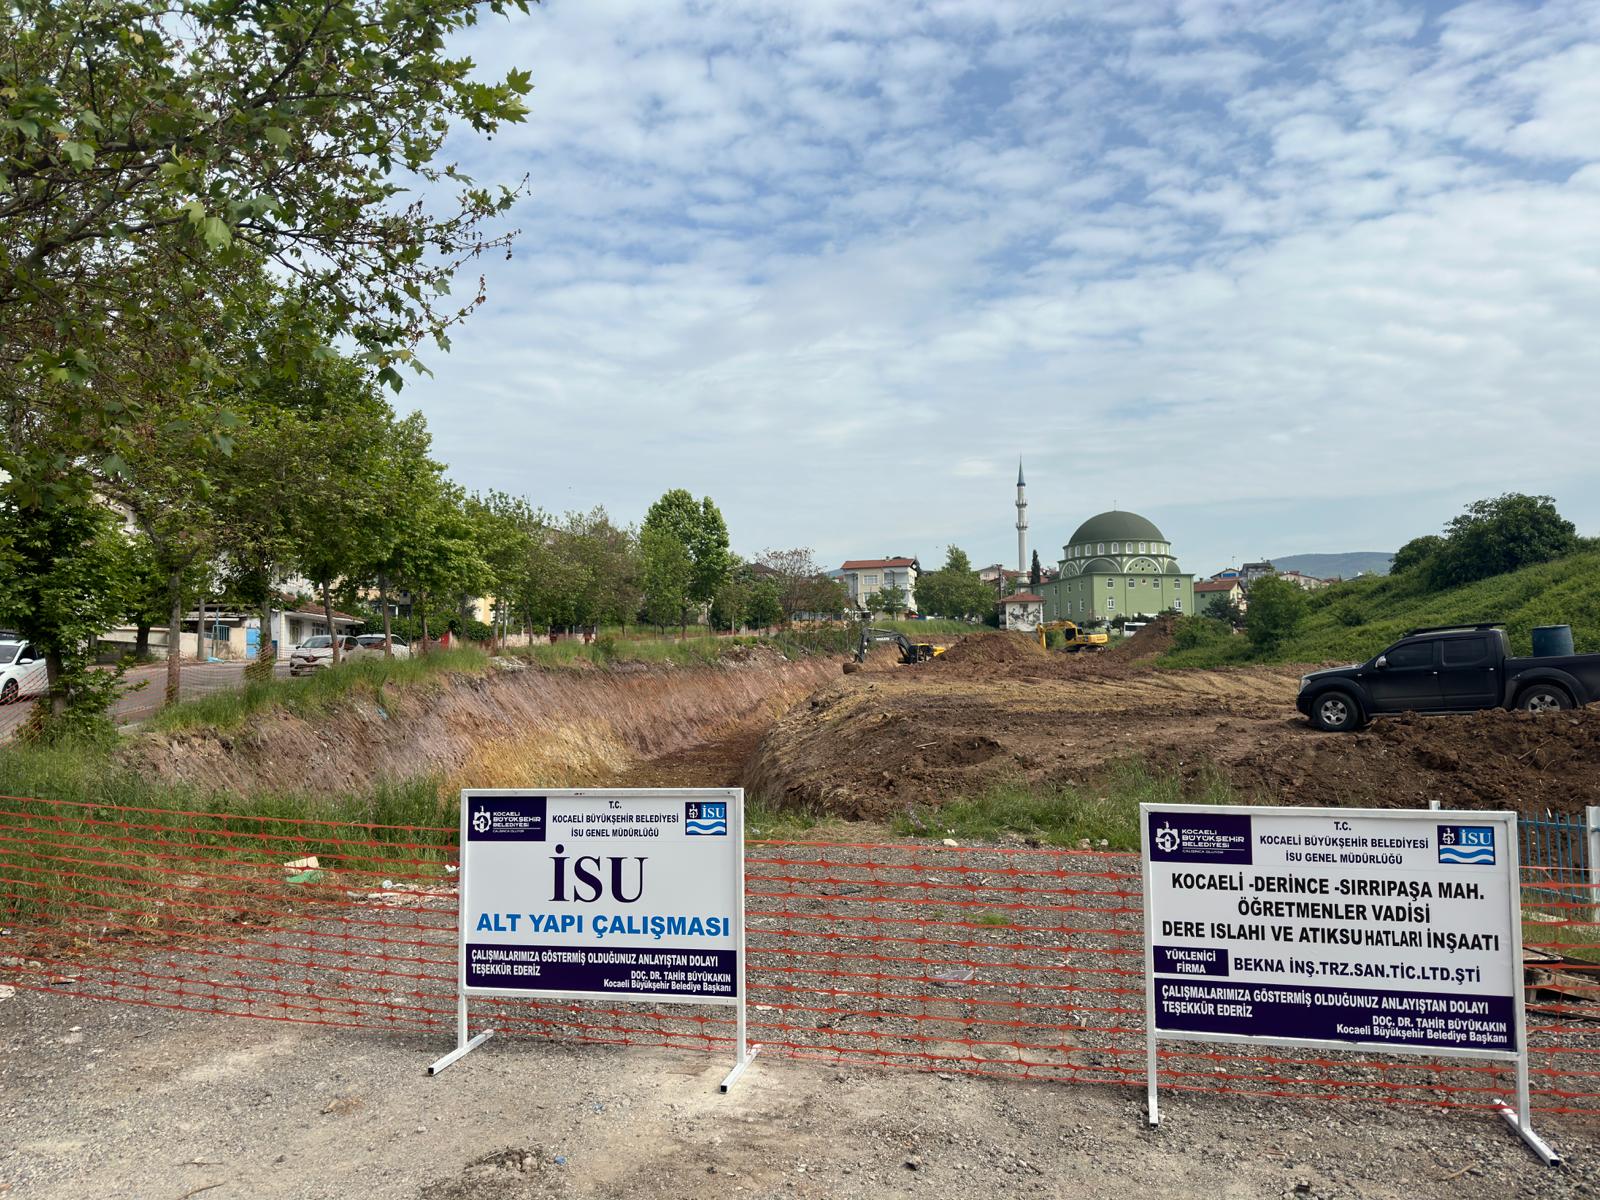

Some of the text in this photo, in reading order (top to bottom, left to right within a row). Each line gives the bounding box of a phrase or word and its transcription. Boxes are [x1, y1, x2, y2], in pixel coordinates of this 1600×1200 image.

[552, 813, 678, 825] KOCAELİ BÜYÜKŞEHİR BELEDİYESİ
[702, 805, 724, 818] İSU
[571, 827, 658, 837] İSU GENEL MÜDÜRLÜĞÜ
[1334, 822, 1352, 831] T.C.
[1182, 834, 1244, 843] BÜYÜKŞEHİR
[1260, 836, 1428, 850] KOCAELİ BÜYÜKŞEHİR BELEDİYESİ
[1460, 829, 1491, 845] İSU
[1286, 852, 1402, 864] İSU GENEL MÜDÜRLÜĞÜ
[548, 844, 648, 903] İSU
[1172, 872, 1484, 901] KOCAELİ -DERİNCE -SIRRIPAŞA MAH.
[1238, 896, 1430, 923] ÖĞRETMENLER VADİSİ
[476, 913, 730, 940] ALT YAPI ÇALIŞMASI
[1162, 921, 1499, 953] DERE ISLAHI VE ATIKSU HATLARI İNŞAATI
[472, 950, 718, 968] ÇALIŞMALARIMIZA GÖSTERMİŞ OLDUĞUNUZ ANLAYIŞTAN DOLAYI
[1166, 949, 1216, 962] YÜKLENİCİ
[472, 962, 540, 976] TEŞEKKÜR EDERİZ
[1176, 962, 1206, 974] FİRMA
[1234, 957, 1480, 985] BEKNA İNŞ.TRZ.SAN.TİC.LTD.ŞTİ
[631, 970, 730, 982] DOÇ. DR. TAHİR BÜYÜKAKIN
[604, 979, 731, 993] Kocaeli Büyükşehir Belediye Başkanı
[1162, 985, 1488, 1014] ÇALIŞMALARIMIZA GÖSTERMİŞ OLDUĞUNUZ ANLAYIŞTAN DOLAYI
[1162, 1001, 1252, 1018] TEŞEKKÜR EDERİZ
[1372, 1016, 1506, 1032] DOÇ. DR. TAHİR BÜYÜKAKIN
[1336, 1024, 1508, 1044] Kocaeli Büyükşehir Belediye Başkanı
